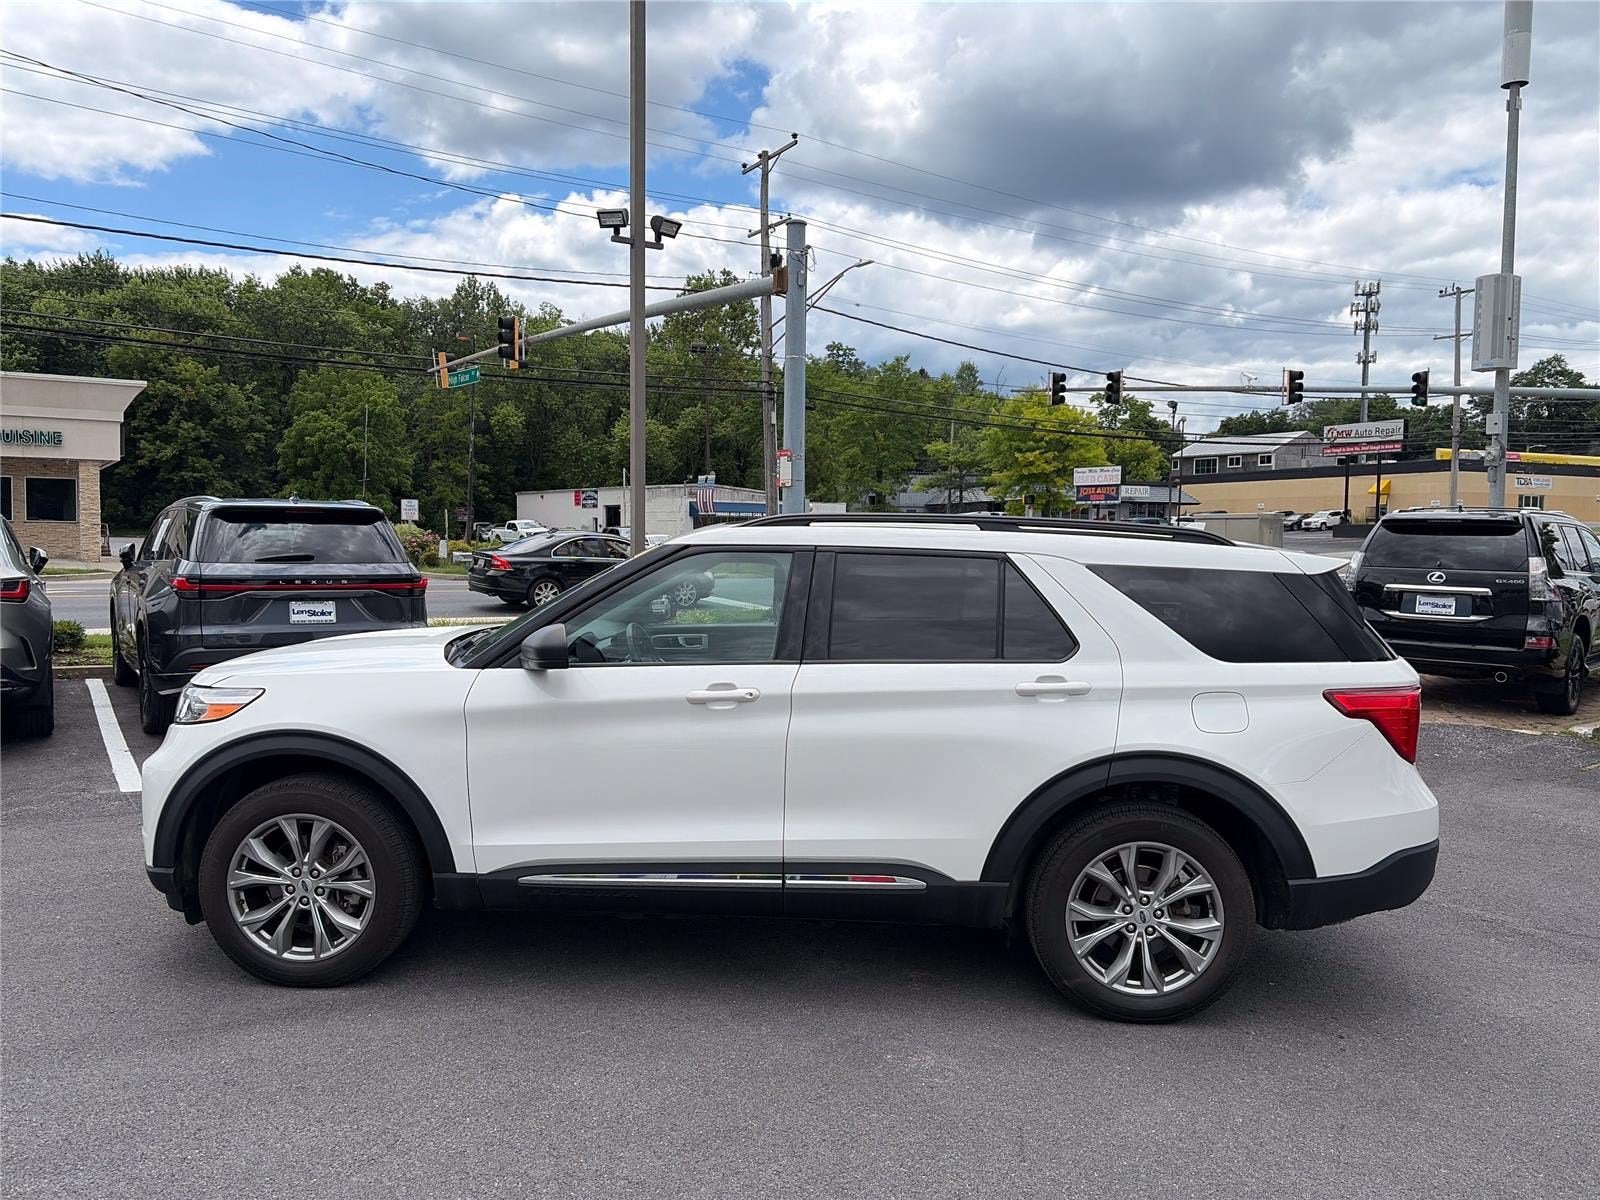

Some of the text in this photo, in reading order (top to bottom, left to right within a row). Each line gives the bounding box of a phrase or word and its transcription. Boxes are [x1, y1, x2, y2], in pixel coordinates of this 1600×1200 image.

[1354, 429, 1373, 437] Auto
[1375, 426, 1401, 435] Repair
[0, 429, 63, 446] UISINE
[1124, 487, 1149, 495] REPAIR
